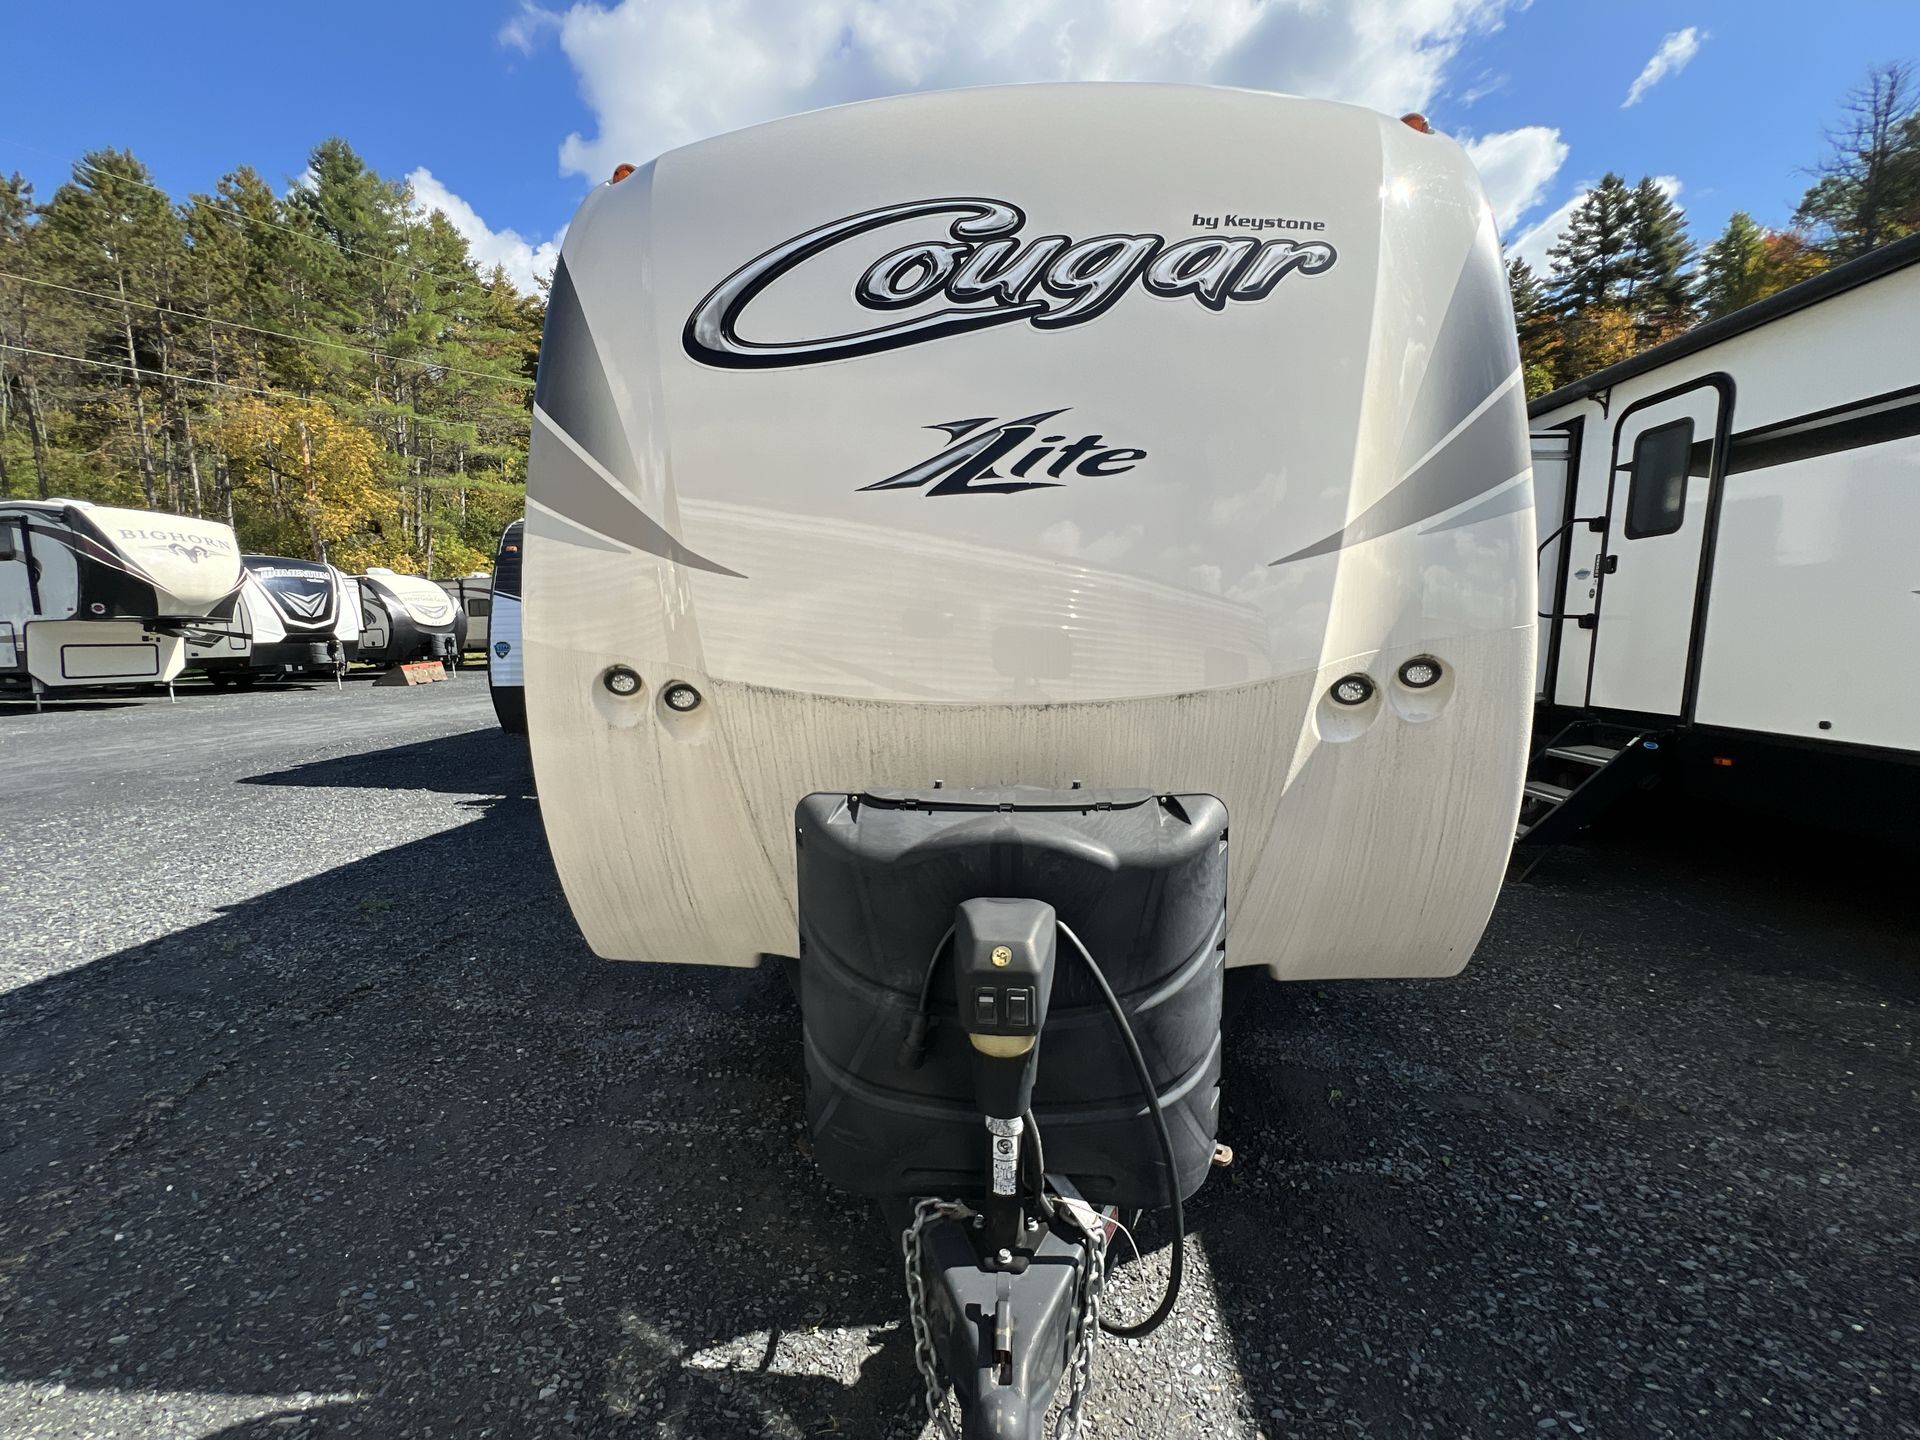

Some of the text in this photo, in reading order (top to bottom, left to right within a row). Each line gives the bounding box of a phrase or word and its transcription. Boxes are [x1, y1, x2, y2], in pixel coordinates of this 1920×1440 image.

[1192, 213, 1326, 232] by Keystone
[682, 197, 1338, 369] Cougar
[118, 528, 232, 550] BIGHORN
